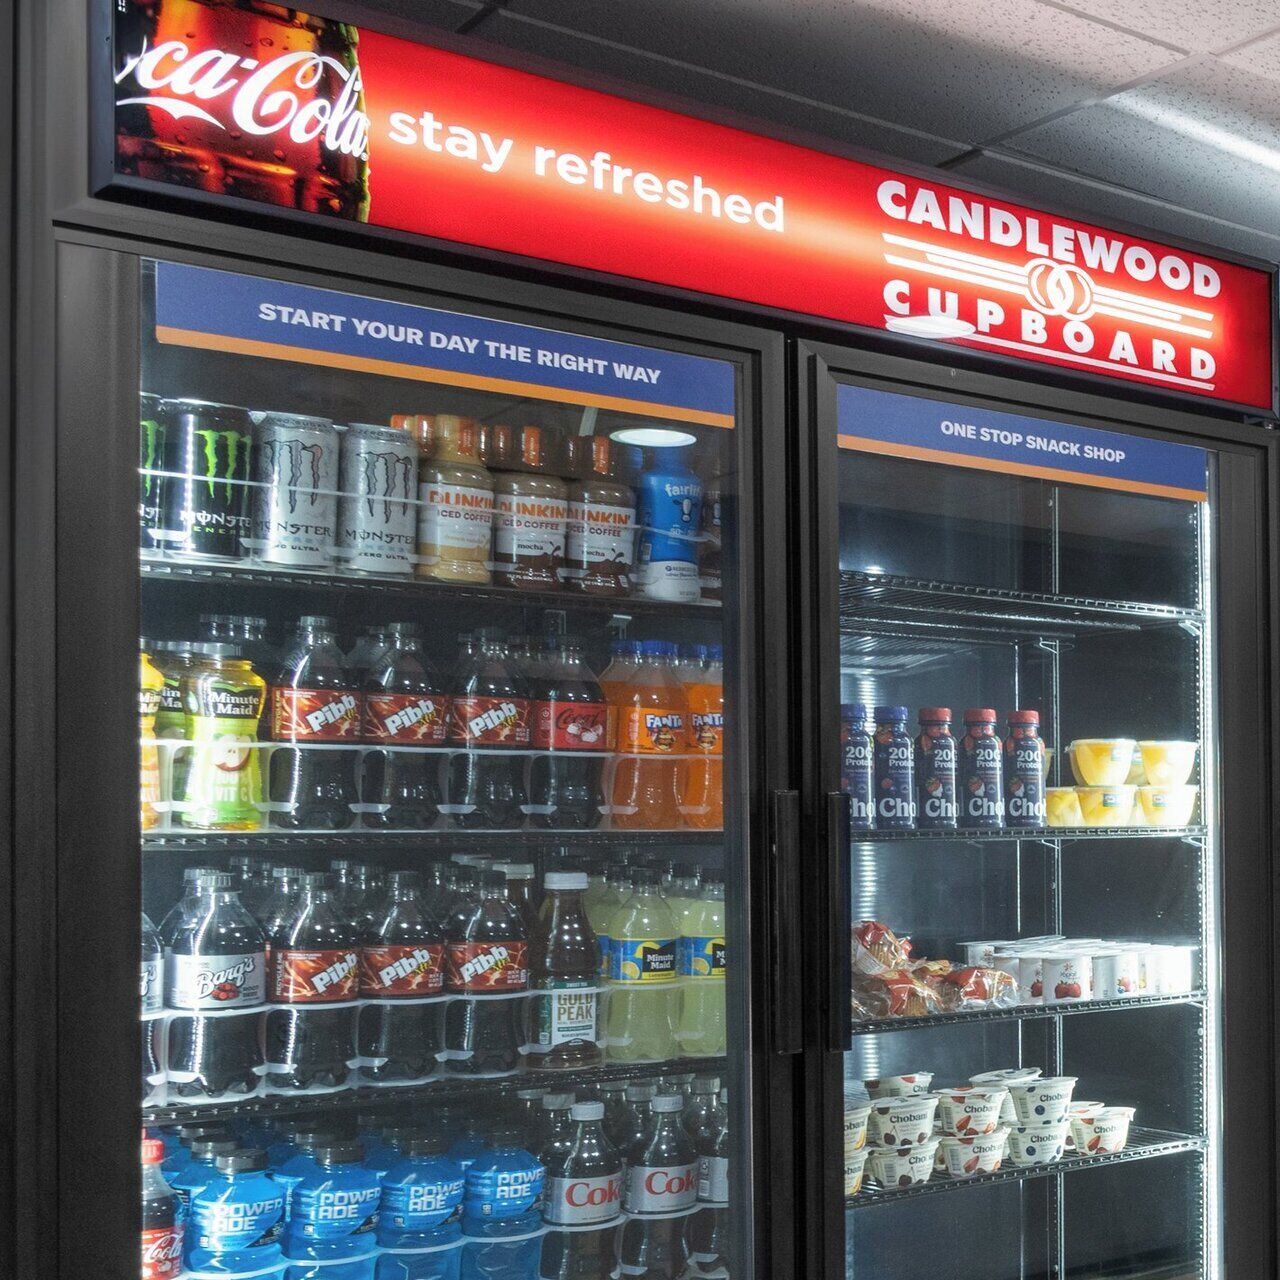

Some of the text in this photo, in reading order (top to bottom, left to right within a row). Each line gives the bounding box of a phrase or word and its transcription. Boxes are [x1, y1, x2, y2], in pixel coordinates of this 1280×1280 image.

[388, 107, 785, 233] stay refreshed
[876, 179, 1221, 299] CANDLEWOOD
[258, 302, 661, 385] START YOUR DAY THE RIGHT WAY
[883, 279, 1217, 381] CUPBOARD
[940, 420, 1126, 464] ONE STOP SNACK SHOP
[211, 692, 260, 705] Minute
[216, 703, 253, 716] Maid
[305, 695, 355, 733] Pibb
[384, 699, 434, 735] Pibb
[468, 702, 517, 737] Pibb
[194, 957, 255, 998] Barq's
[310, 953, 358, 993] Pibb
[378, 948, 431, 987] Pibb
[459, 945, 510, 983] Pibb
[557, 1007, 593, 1021] PEAK
[320, 1187, 381, 1207] POWER
[409, 1197, 446, 1212] ADE
[496, 1184, 531, 1199] ADE
[319, 1205, 358, 1219] ADE
